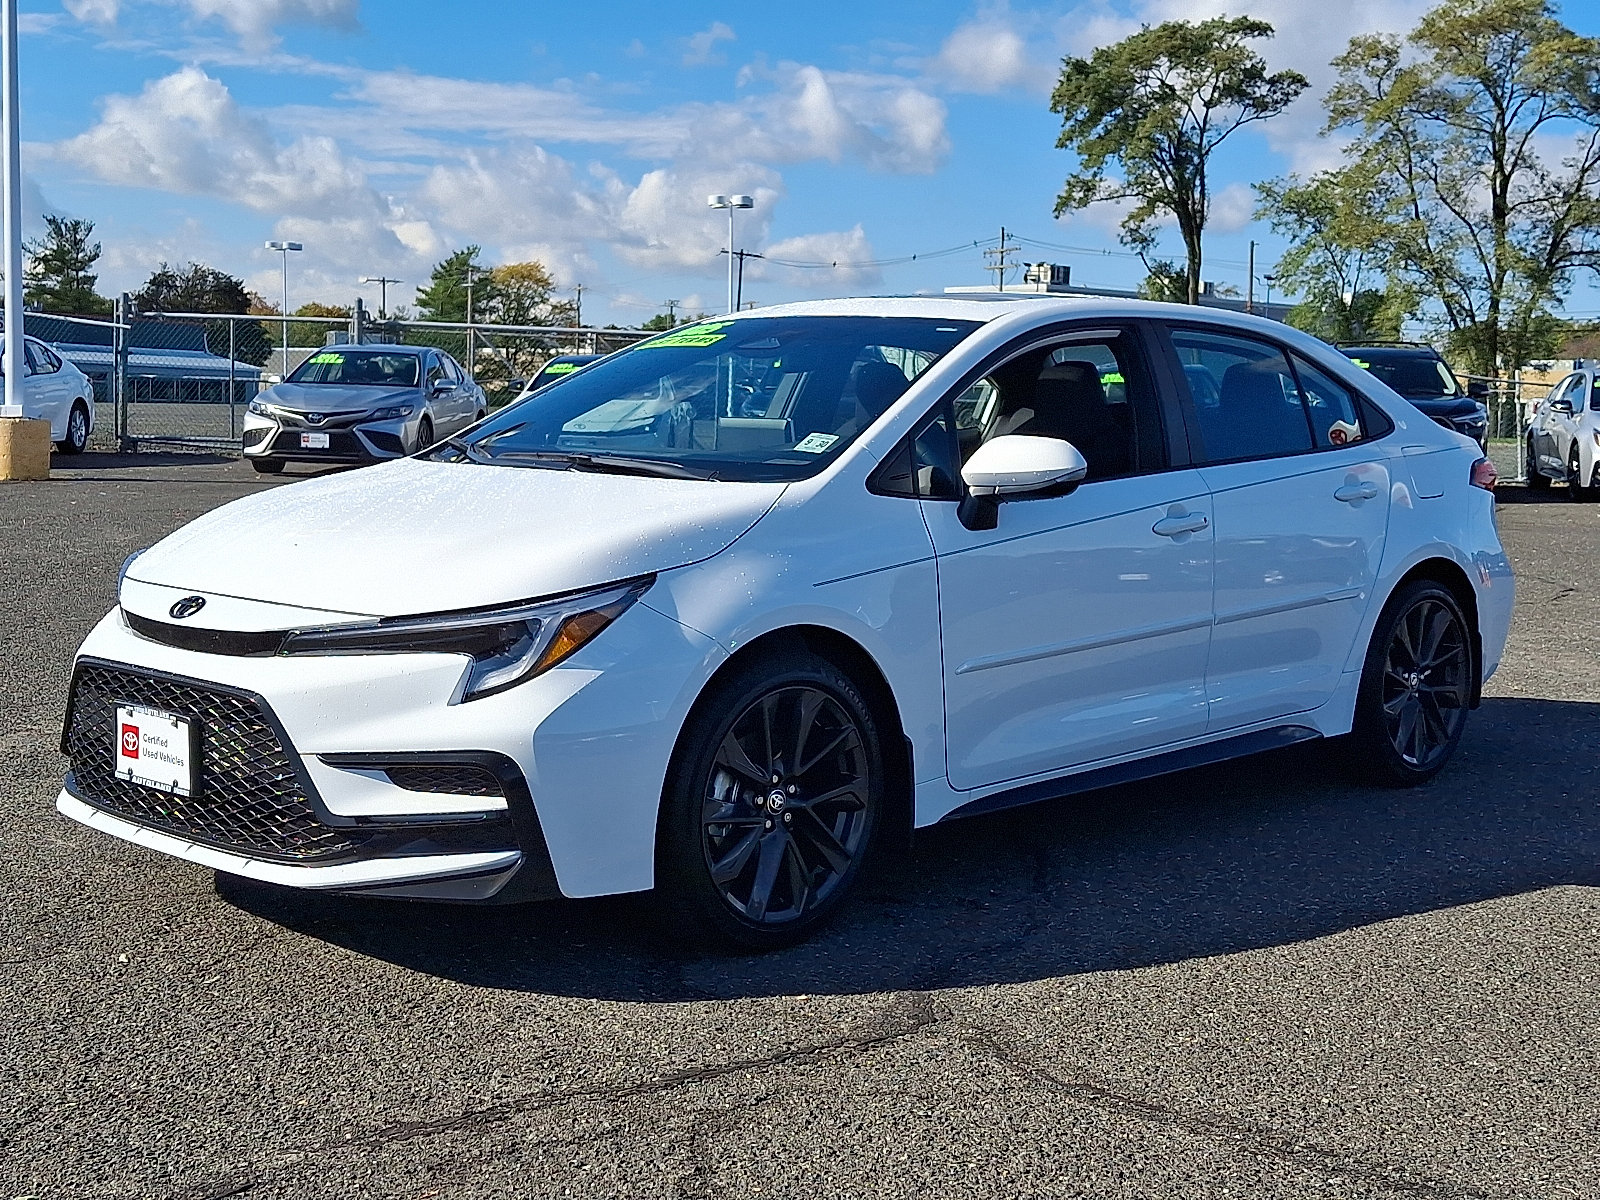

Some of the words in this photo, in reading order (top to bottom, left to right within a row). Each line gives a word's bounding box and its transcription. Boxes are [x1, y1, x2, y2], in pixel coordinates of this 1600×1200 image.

[142, 733, 168, 748] Certified
[142, 747, 159, 760] Used
[160, 751, 184, 767] Vehicles
